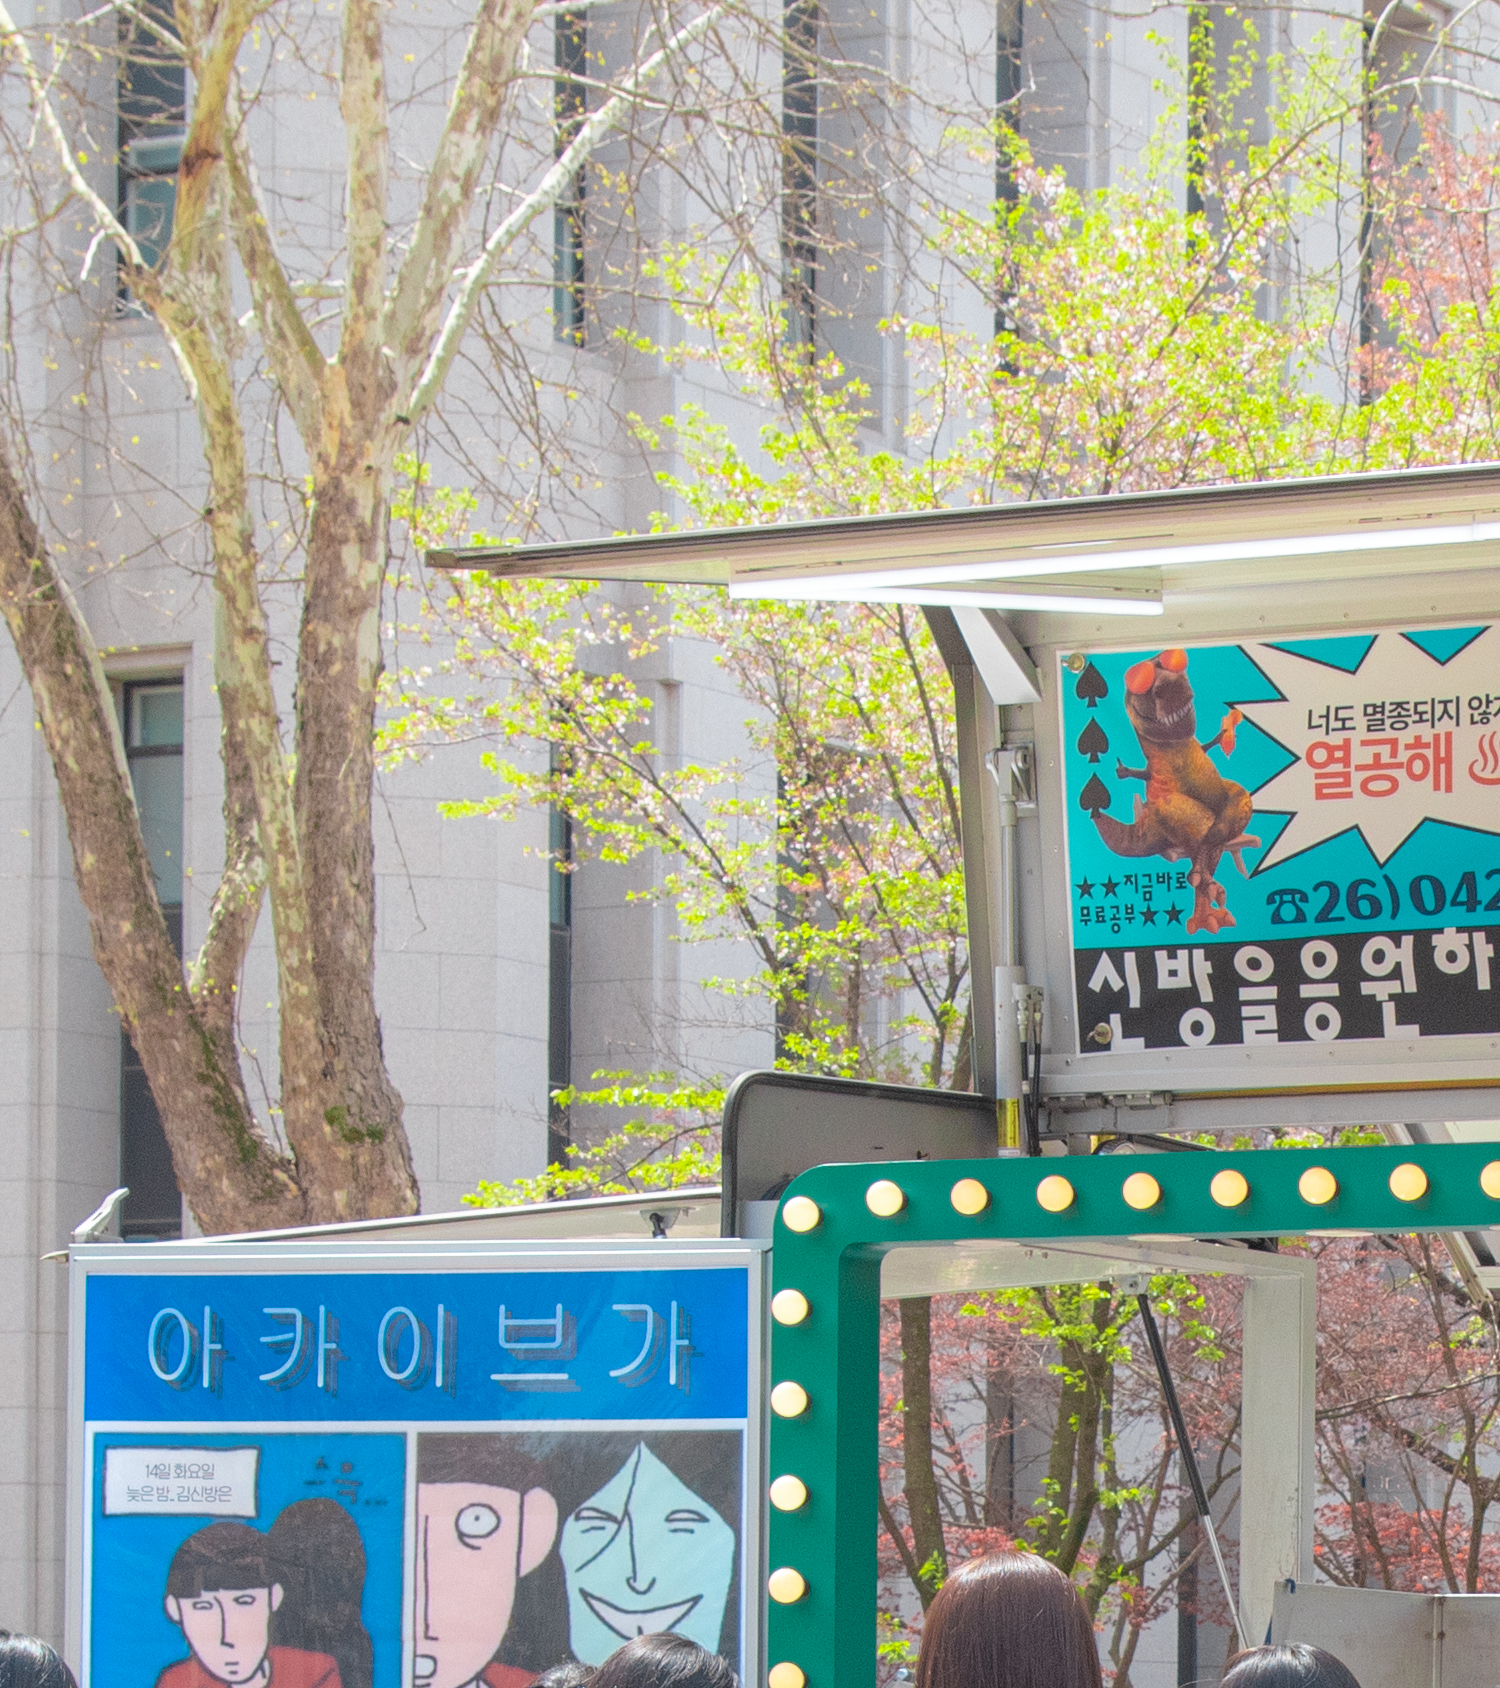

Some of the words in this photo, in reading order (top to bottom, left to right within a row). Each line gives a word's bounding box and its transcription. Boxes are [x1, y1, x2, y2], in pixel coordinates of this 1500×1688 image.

[1307, 704, 1357, 736] 너도
[1362, 695, 1461, 733] 멸종되지
[1305, 730, 1454, 801] 열공해
[1080, 903, 1136, 934] 무료공부
[146, 1300, 693, 1390] 아카이브가
[145, 1463, 171, 1480] 14일
[173, 1463, 215, 1480] 화요일
